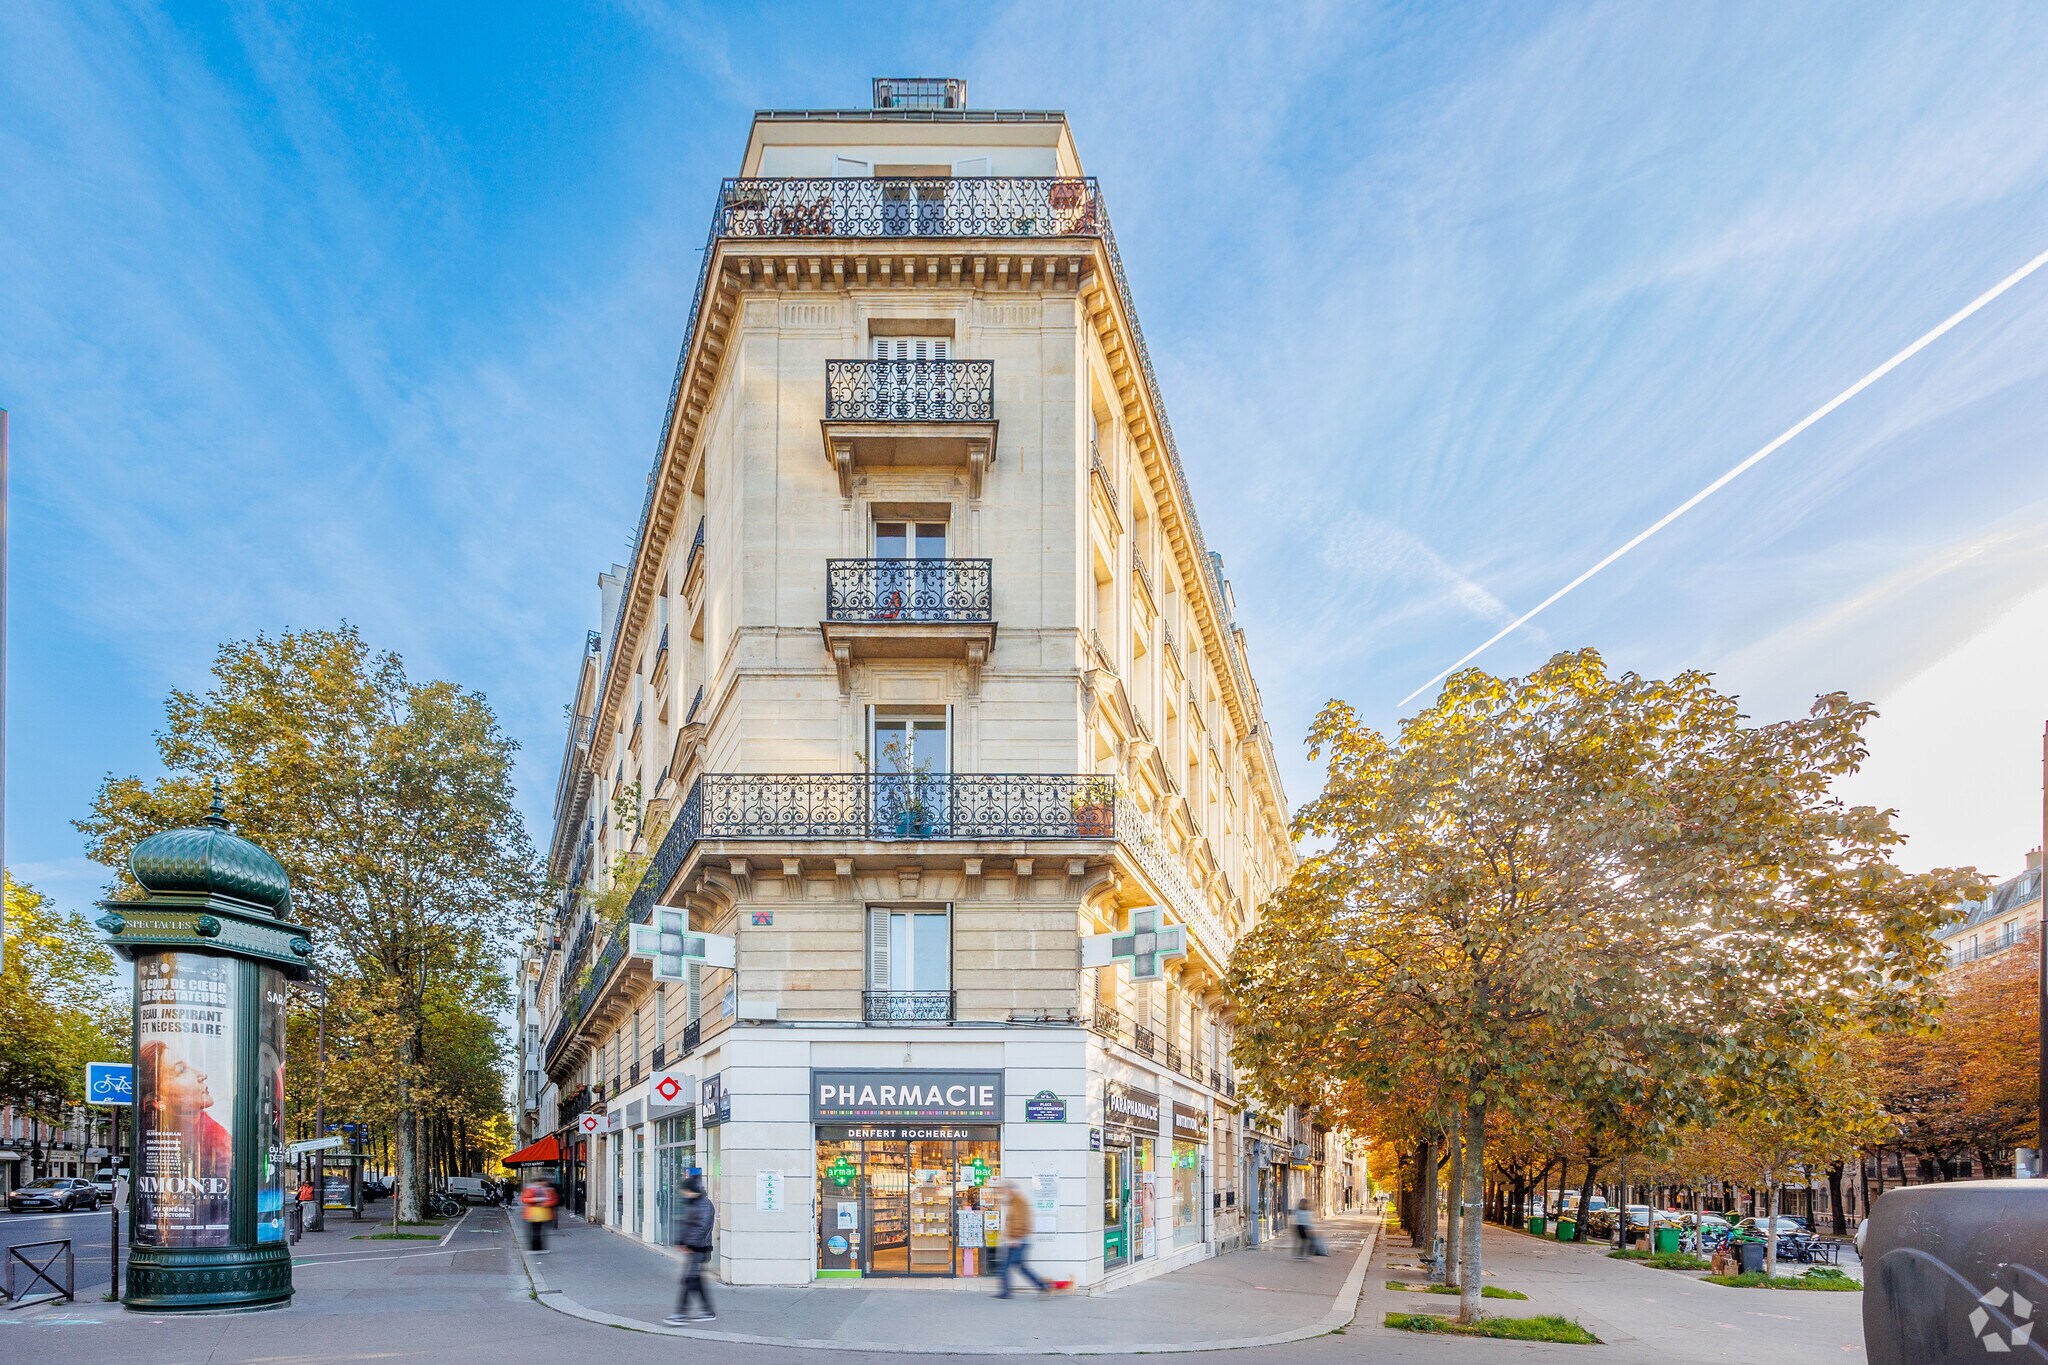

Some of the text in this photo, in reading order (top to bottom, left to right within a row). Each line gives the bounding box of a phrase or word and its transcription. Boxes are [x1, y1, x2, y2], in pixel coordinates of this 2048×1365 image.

[126, 919, 191, 930] SPECTACLES
[147, 979, 169, 991] COUP
[170, 978, 186, 990] DE
[151, 989, 227, 1005] SPECTATEURS
[161, 1008, 223, 1022] INSPIRANT
[142, 1022, 149, 1033] ET
[820, 1085, 994, 1107] PHARMACIE
[1111, 1095, 1158, 1121] PARAPHARMACIE
[848, 1129, 968, 1138] DENFERT ROCHEREAU
[140, 1176, 228, 1194] SIMONE
[162, 1204, 191, 1213] CINÉMA
